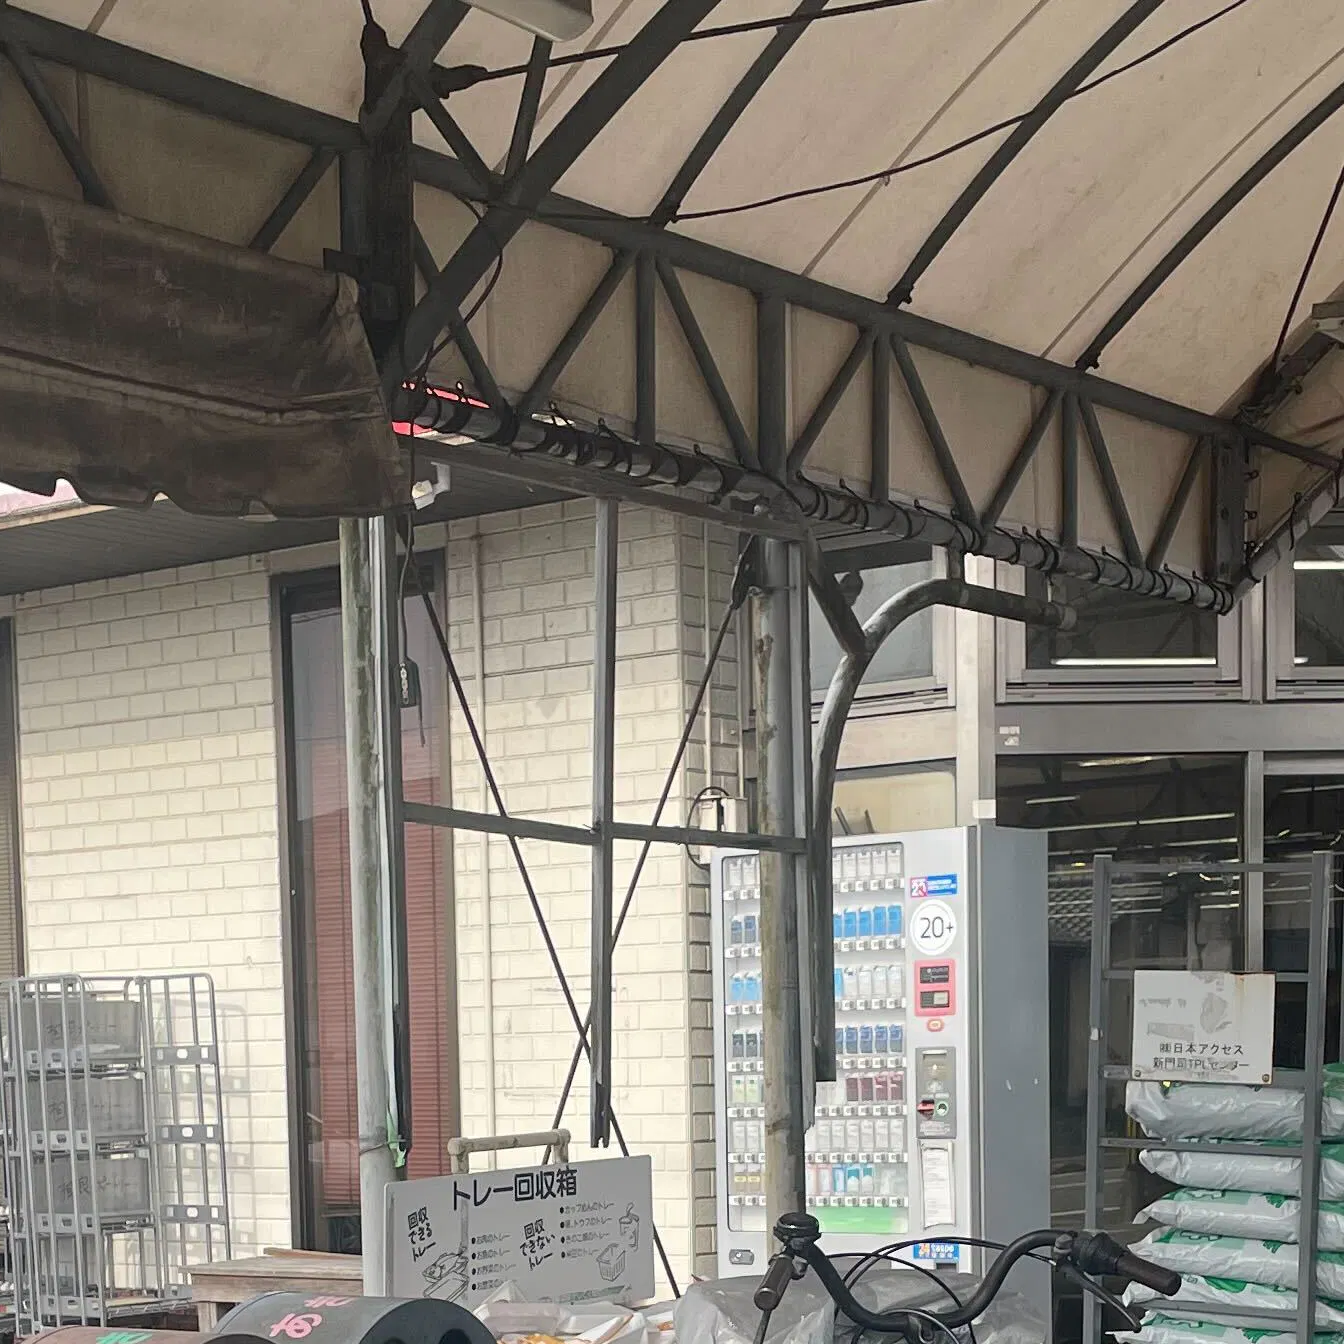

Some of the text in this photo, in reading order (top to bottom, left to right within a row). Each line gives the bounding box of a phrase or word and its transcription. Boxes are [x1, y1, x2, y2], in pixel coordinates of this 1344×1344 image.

[920, 916, 954, 939] 20+
[453, 1164, 578, 1211] トレー回収箱
[407, 1206, 429, 1230] 回収
[523, 1218, 545, 1240] 回収
[407, 1222, 433, 1245] できる
[519, 1233, 556, 1257] できない
[412, 1241, 436, 1263] トレー
[528, 1252, 553, 1272] トレー
